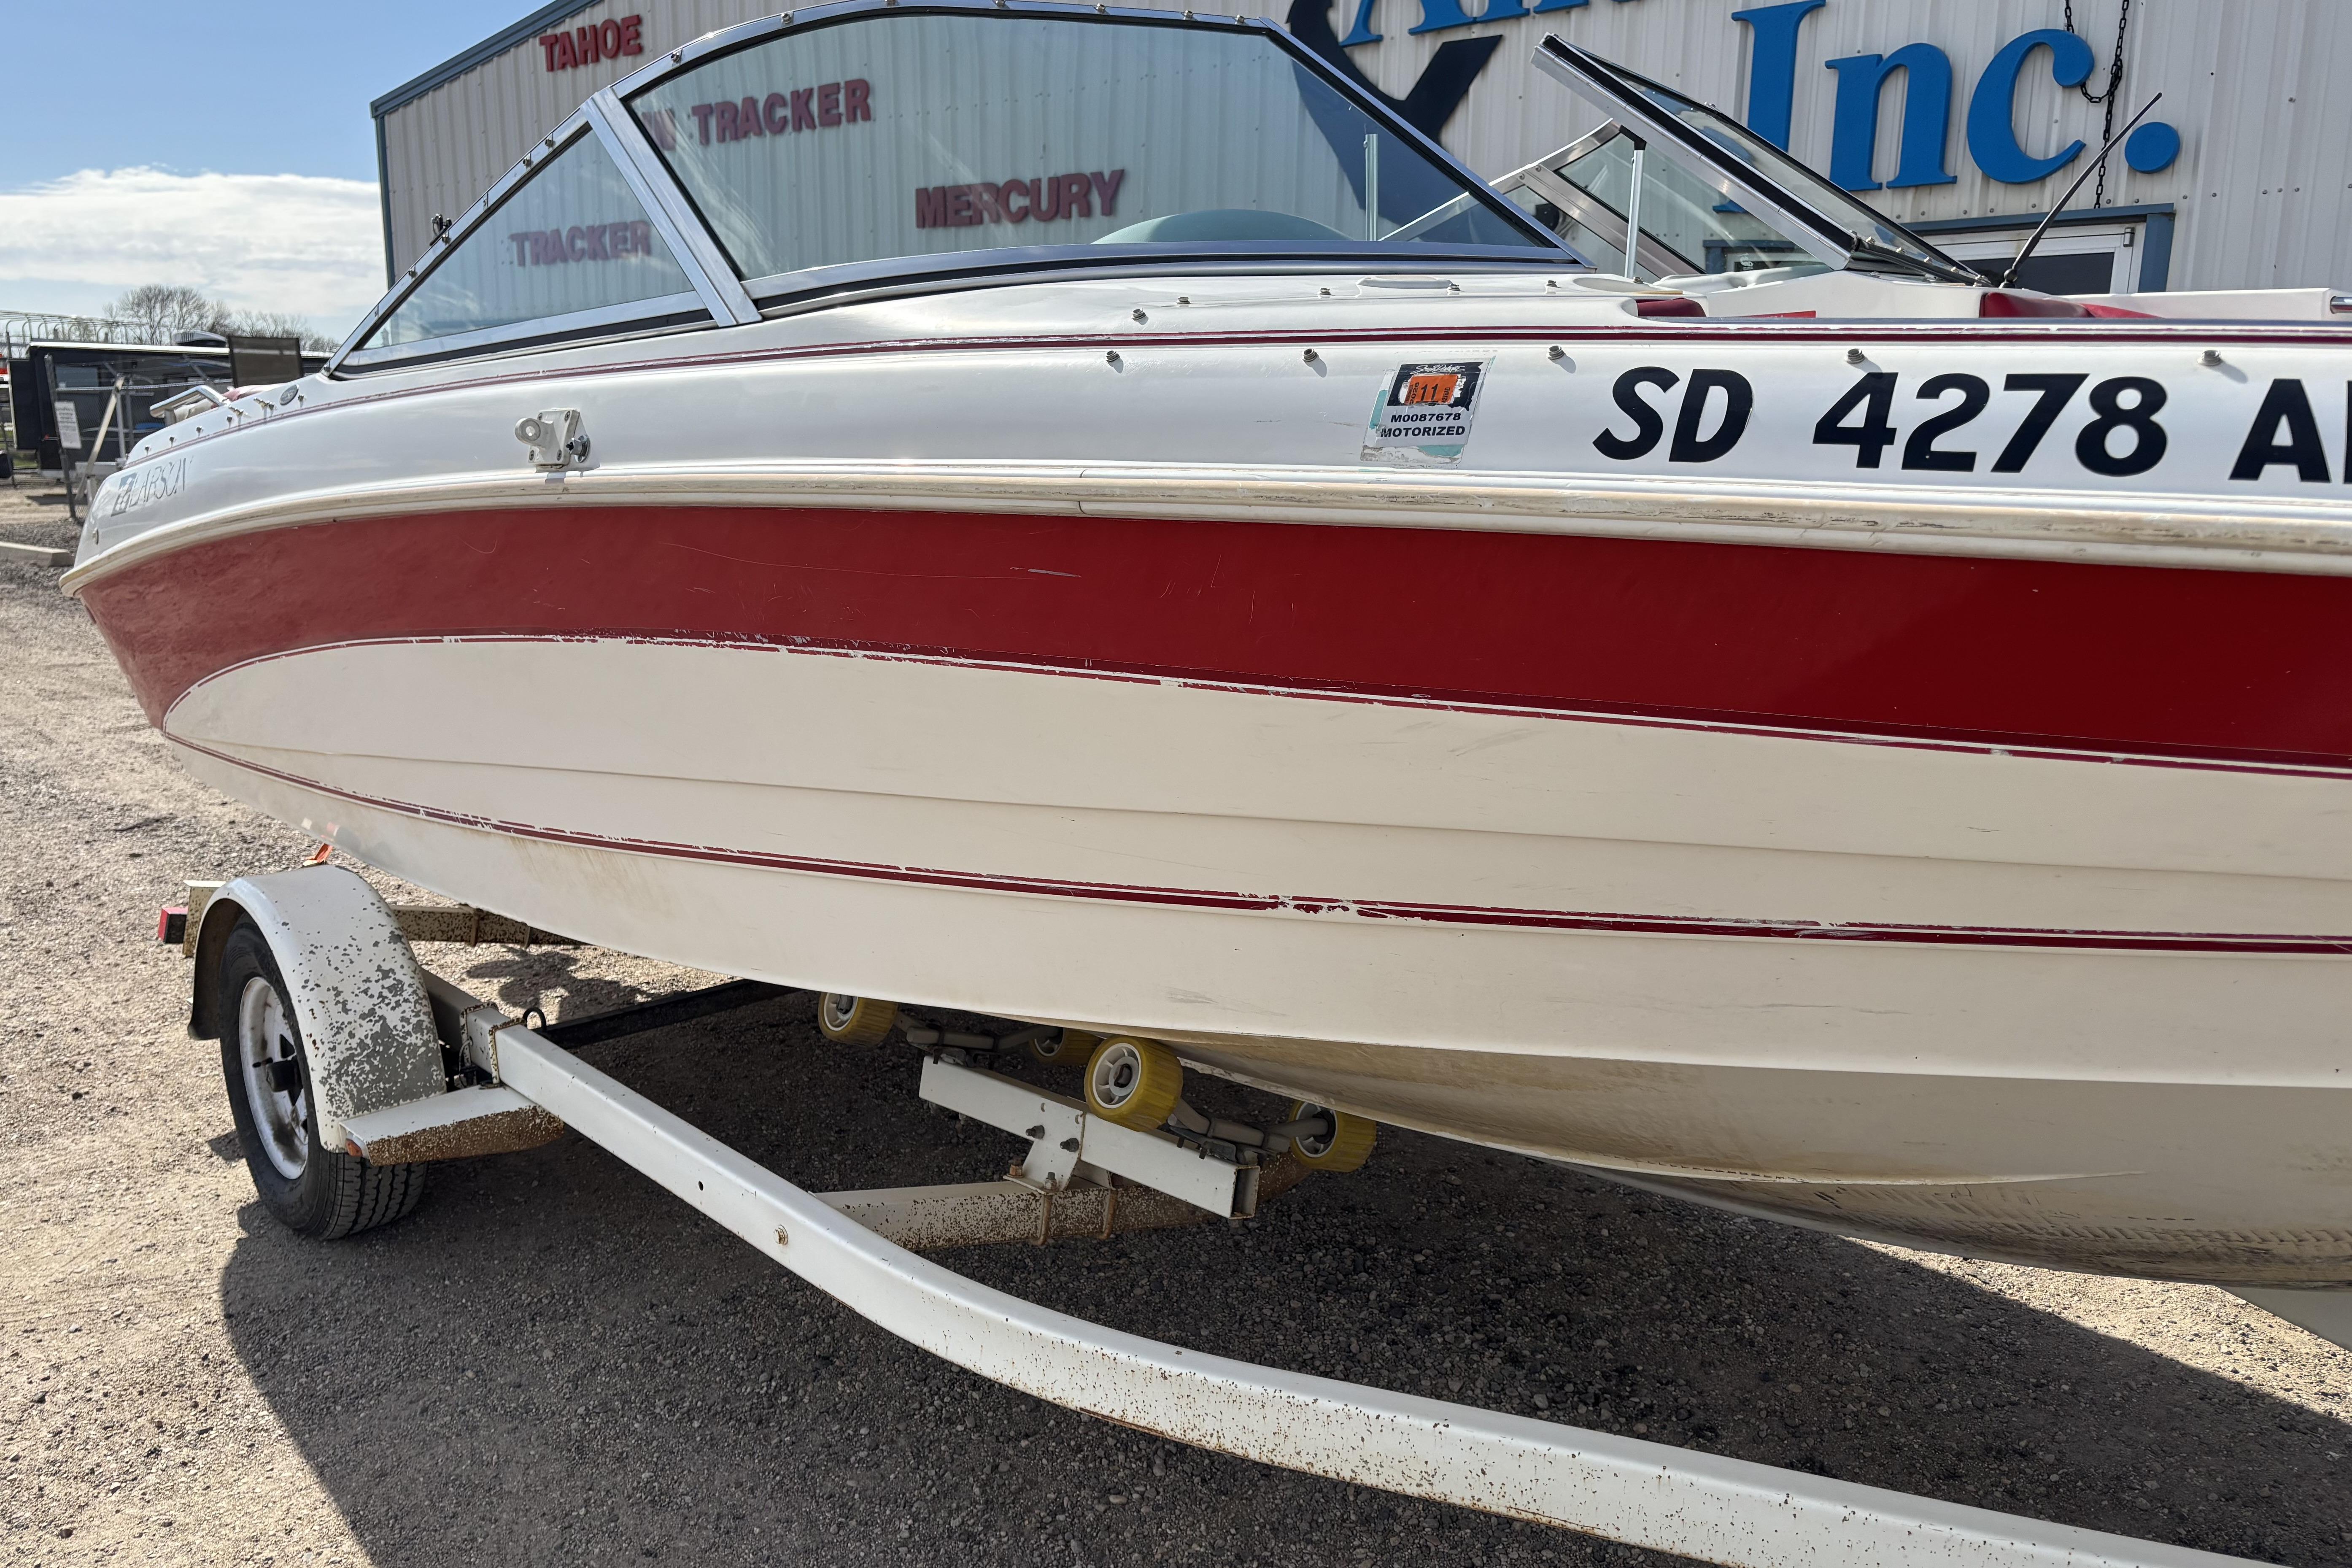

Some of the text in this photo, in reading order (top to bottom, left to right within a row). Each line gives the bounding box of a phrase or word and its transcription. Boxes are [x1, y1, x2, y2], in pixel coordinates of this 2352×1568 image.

[539, 15, 643, 72] TAHOE
[691, 78, 872, 146] TRACKER
[1713, 0, 2181, 213] Inc.
[916, 169, 1125, 229] MERCURY
[508, 220, 652, 267] TRACKER
[1391, 413, 1461, 423] M0087678
[1421, 384, 1438, 401] 11
[1381, 426, 1465, 437] MOTORIZED
[1592, 366, 2352, 484] SD 4278 A
